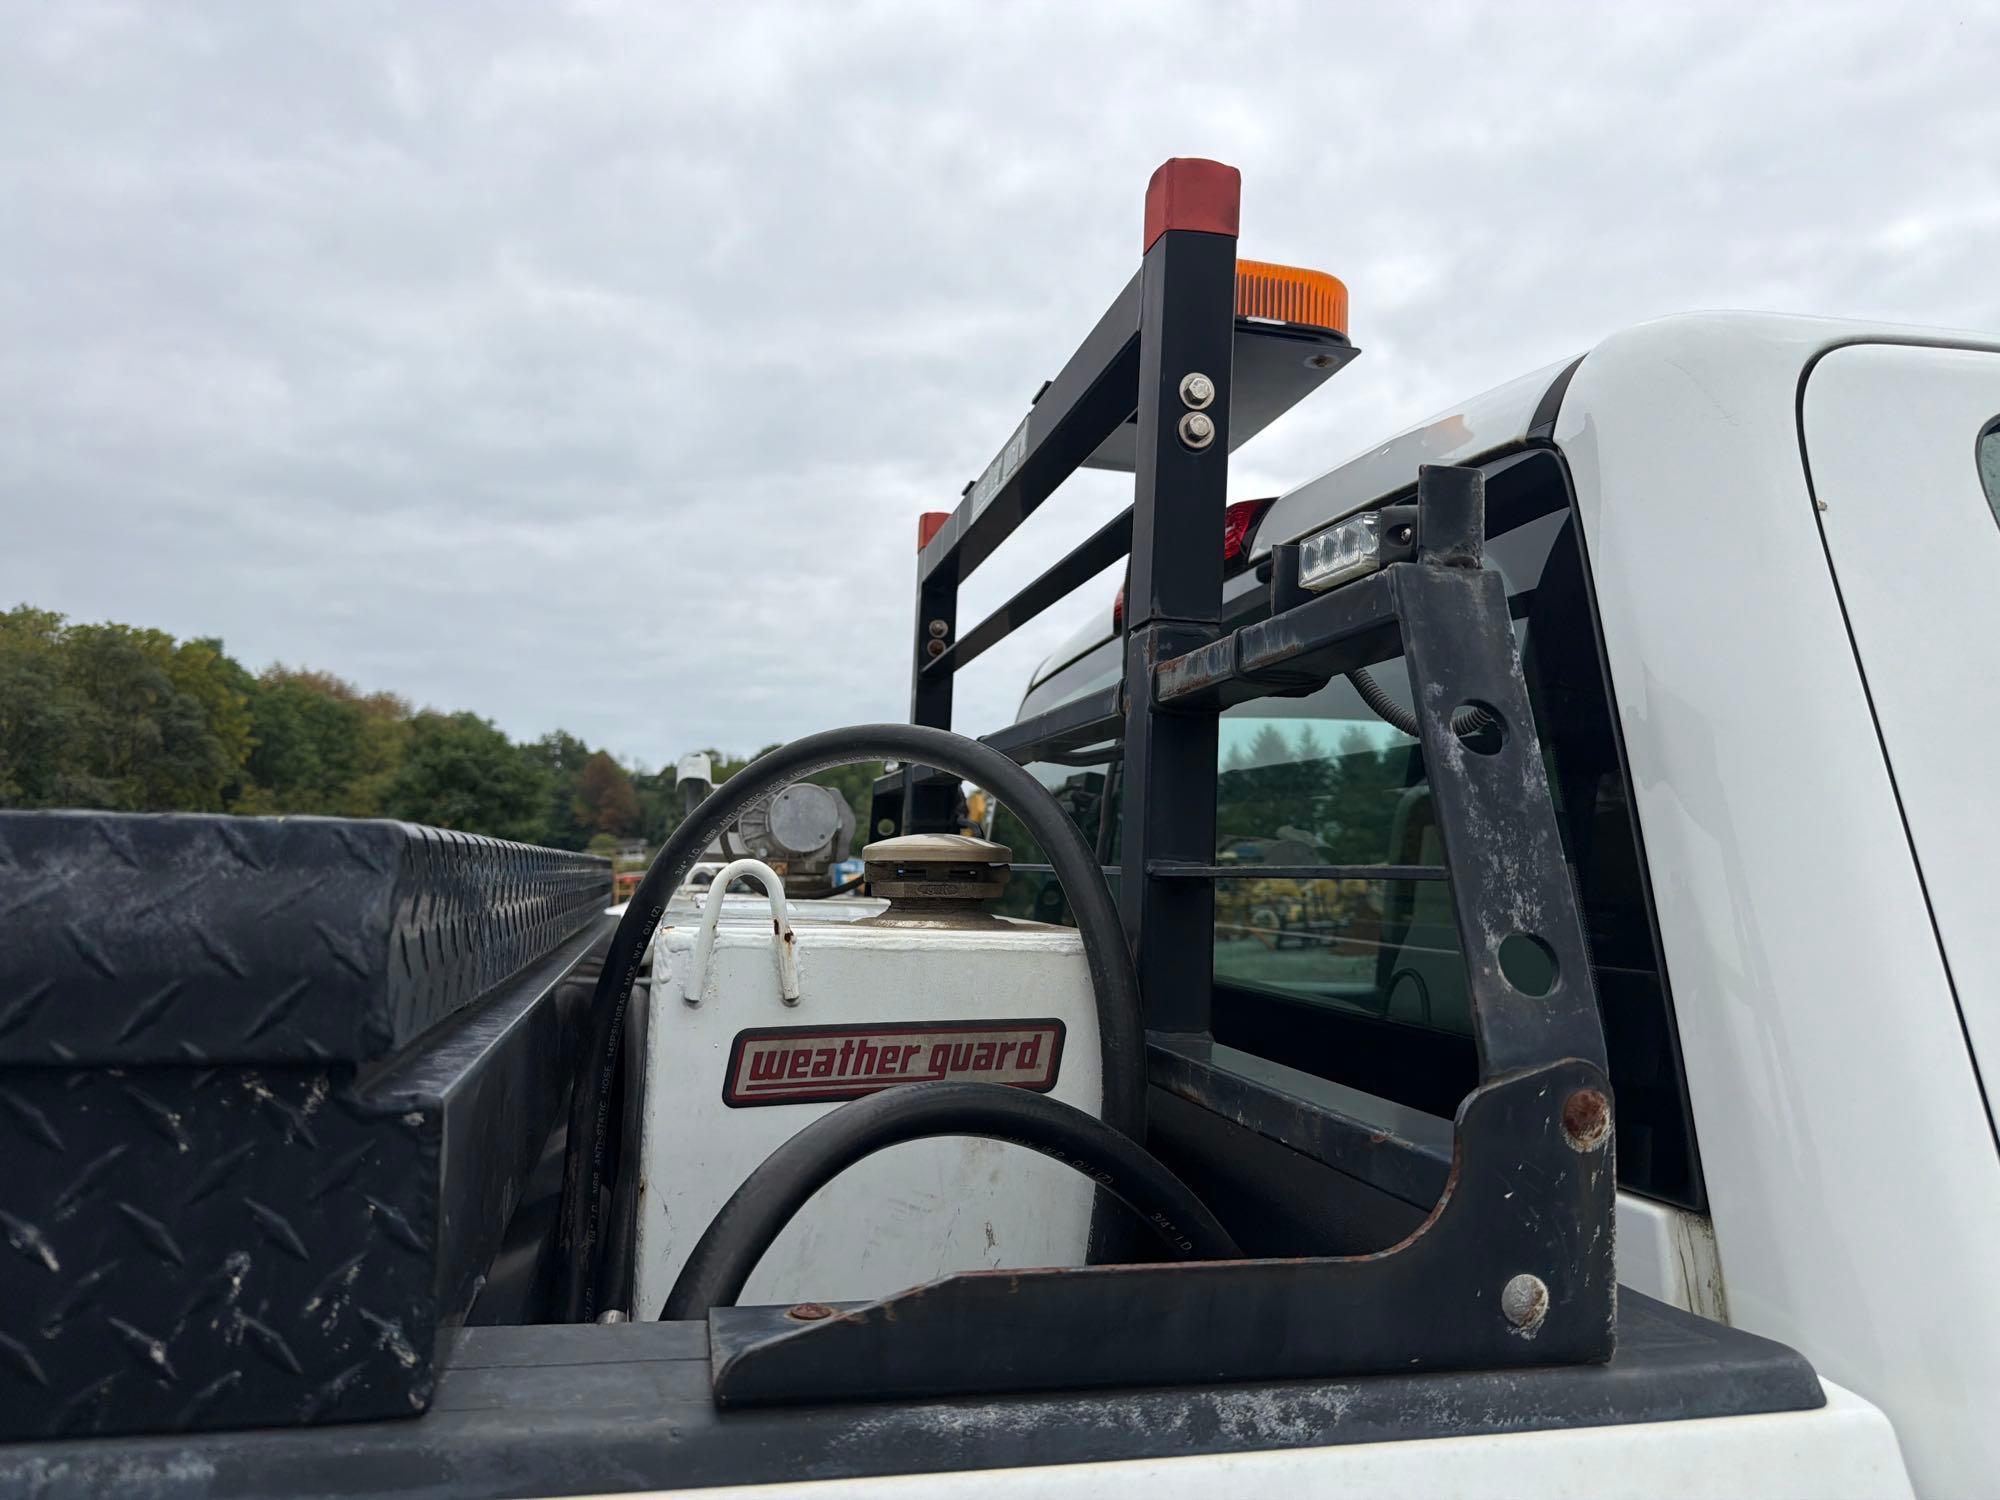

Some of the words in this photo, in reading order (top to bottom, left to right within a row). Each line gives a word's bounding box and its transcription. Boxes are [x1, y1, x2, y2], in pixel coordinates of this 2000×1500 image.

[702, 828, 718, 844] NBR
[720, 793, 762, 828] ANTI-STATIC
[764, 777, 787, 792] HOSE
[624, 965, 637, 986] MAX
[600, 1065, 612, 1094] HOSE
[749, 1039, 922, 1081] weather
[928, 1033, 1043, 1081] guard
[594, 1100, 609, 1168] ANTI-STATIC
